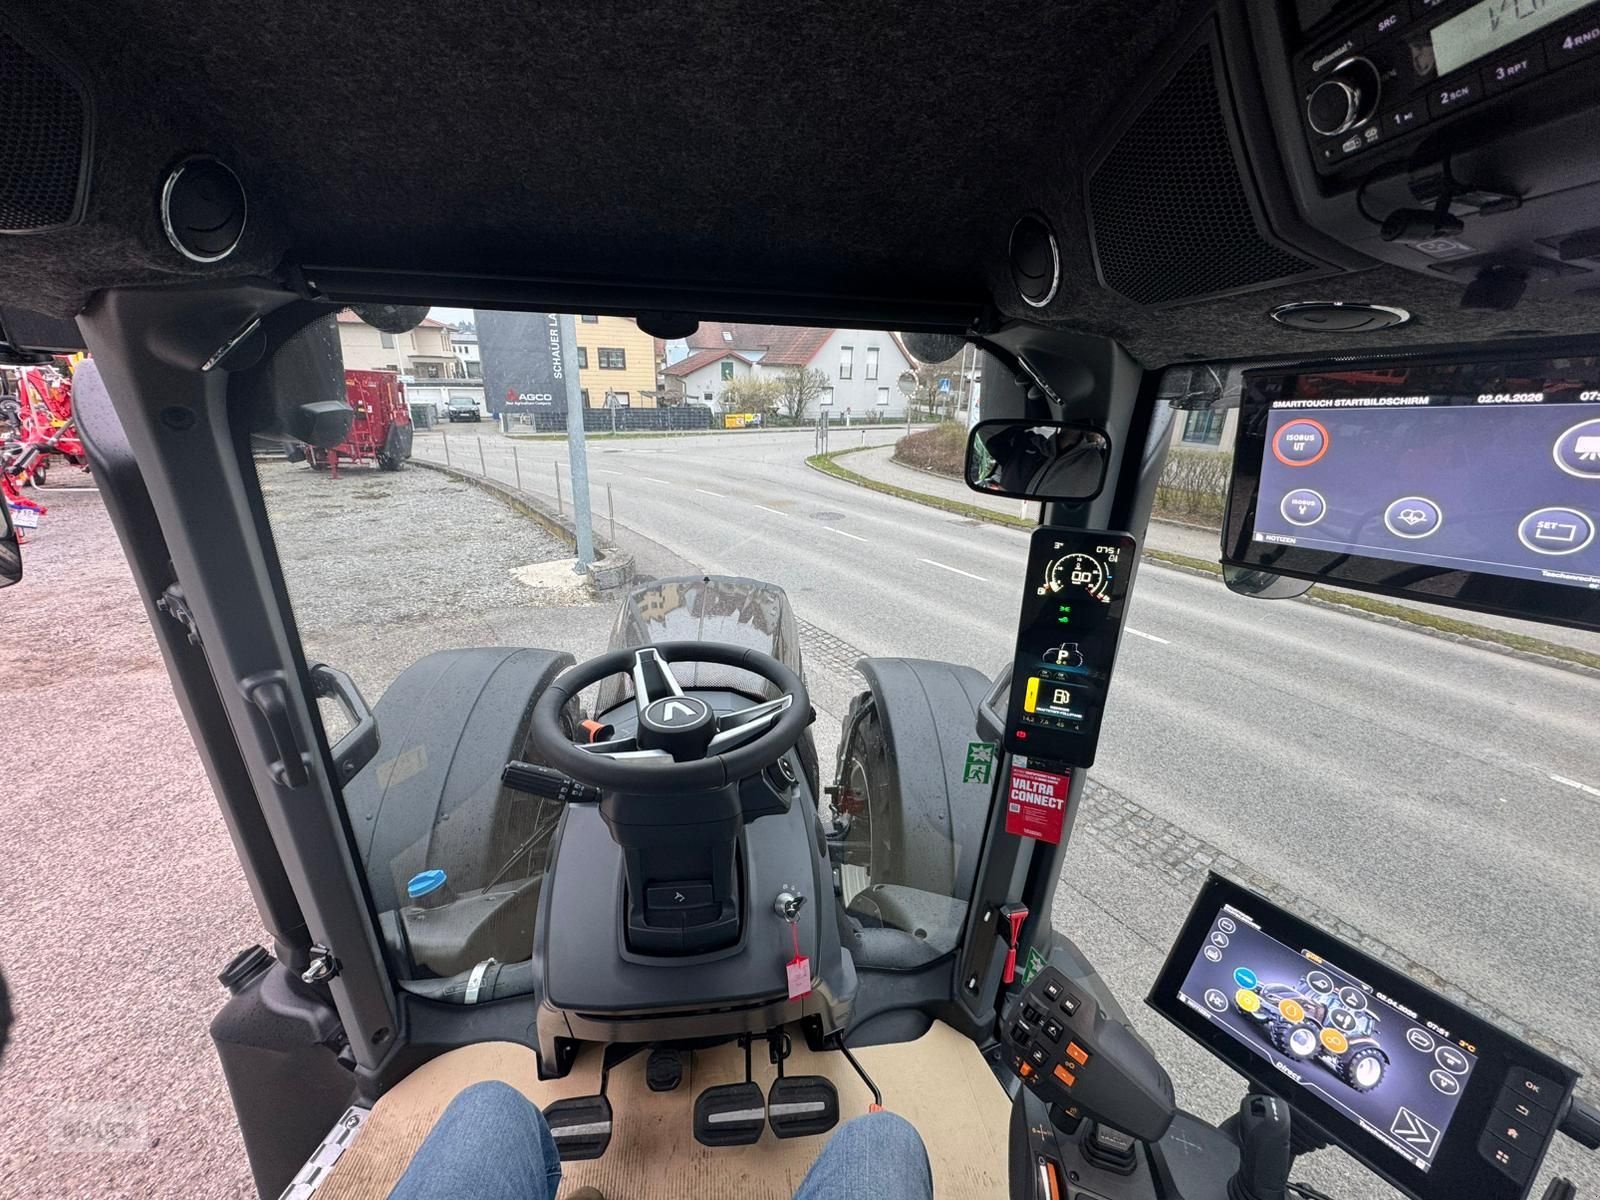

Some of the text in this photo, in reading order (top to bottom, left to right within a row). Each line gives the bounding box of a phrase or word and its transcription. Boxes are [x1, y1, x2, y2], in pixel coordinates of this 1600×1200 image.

[1378, 15, 1397, 31] SRC
[549, 329, 562, 379] SCHAUER
[518, 393, 552, 401] AGCO
[1272, 396, 1429, 408] SMARTTOUCH STARTBILDSCHIRM
[1477, 393, 1544, 404] 02.04.2026
[1286, 434, 1315, 442] ISOBUS
[1293, 442, 1305, 451] UT
[1537, 521, 1558, 530] SET
[1266, 535, 1296, 544] NOTIZEN
[1058, 650, 1069, 661] P
[1012, 777, 1054, 796] VALTRA
[1011, 789, 1064, 810] CONNECT
[1426, 1021, 1450, 1037] 07:51
[1525, 1081, 1539, 1093] OK
